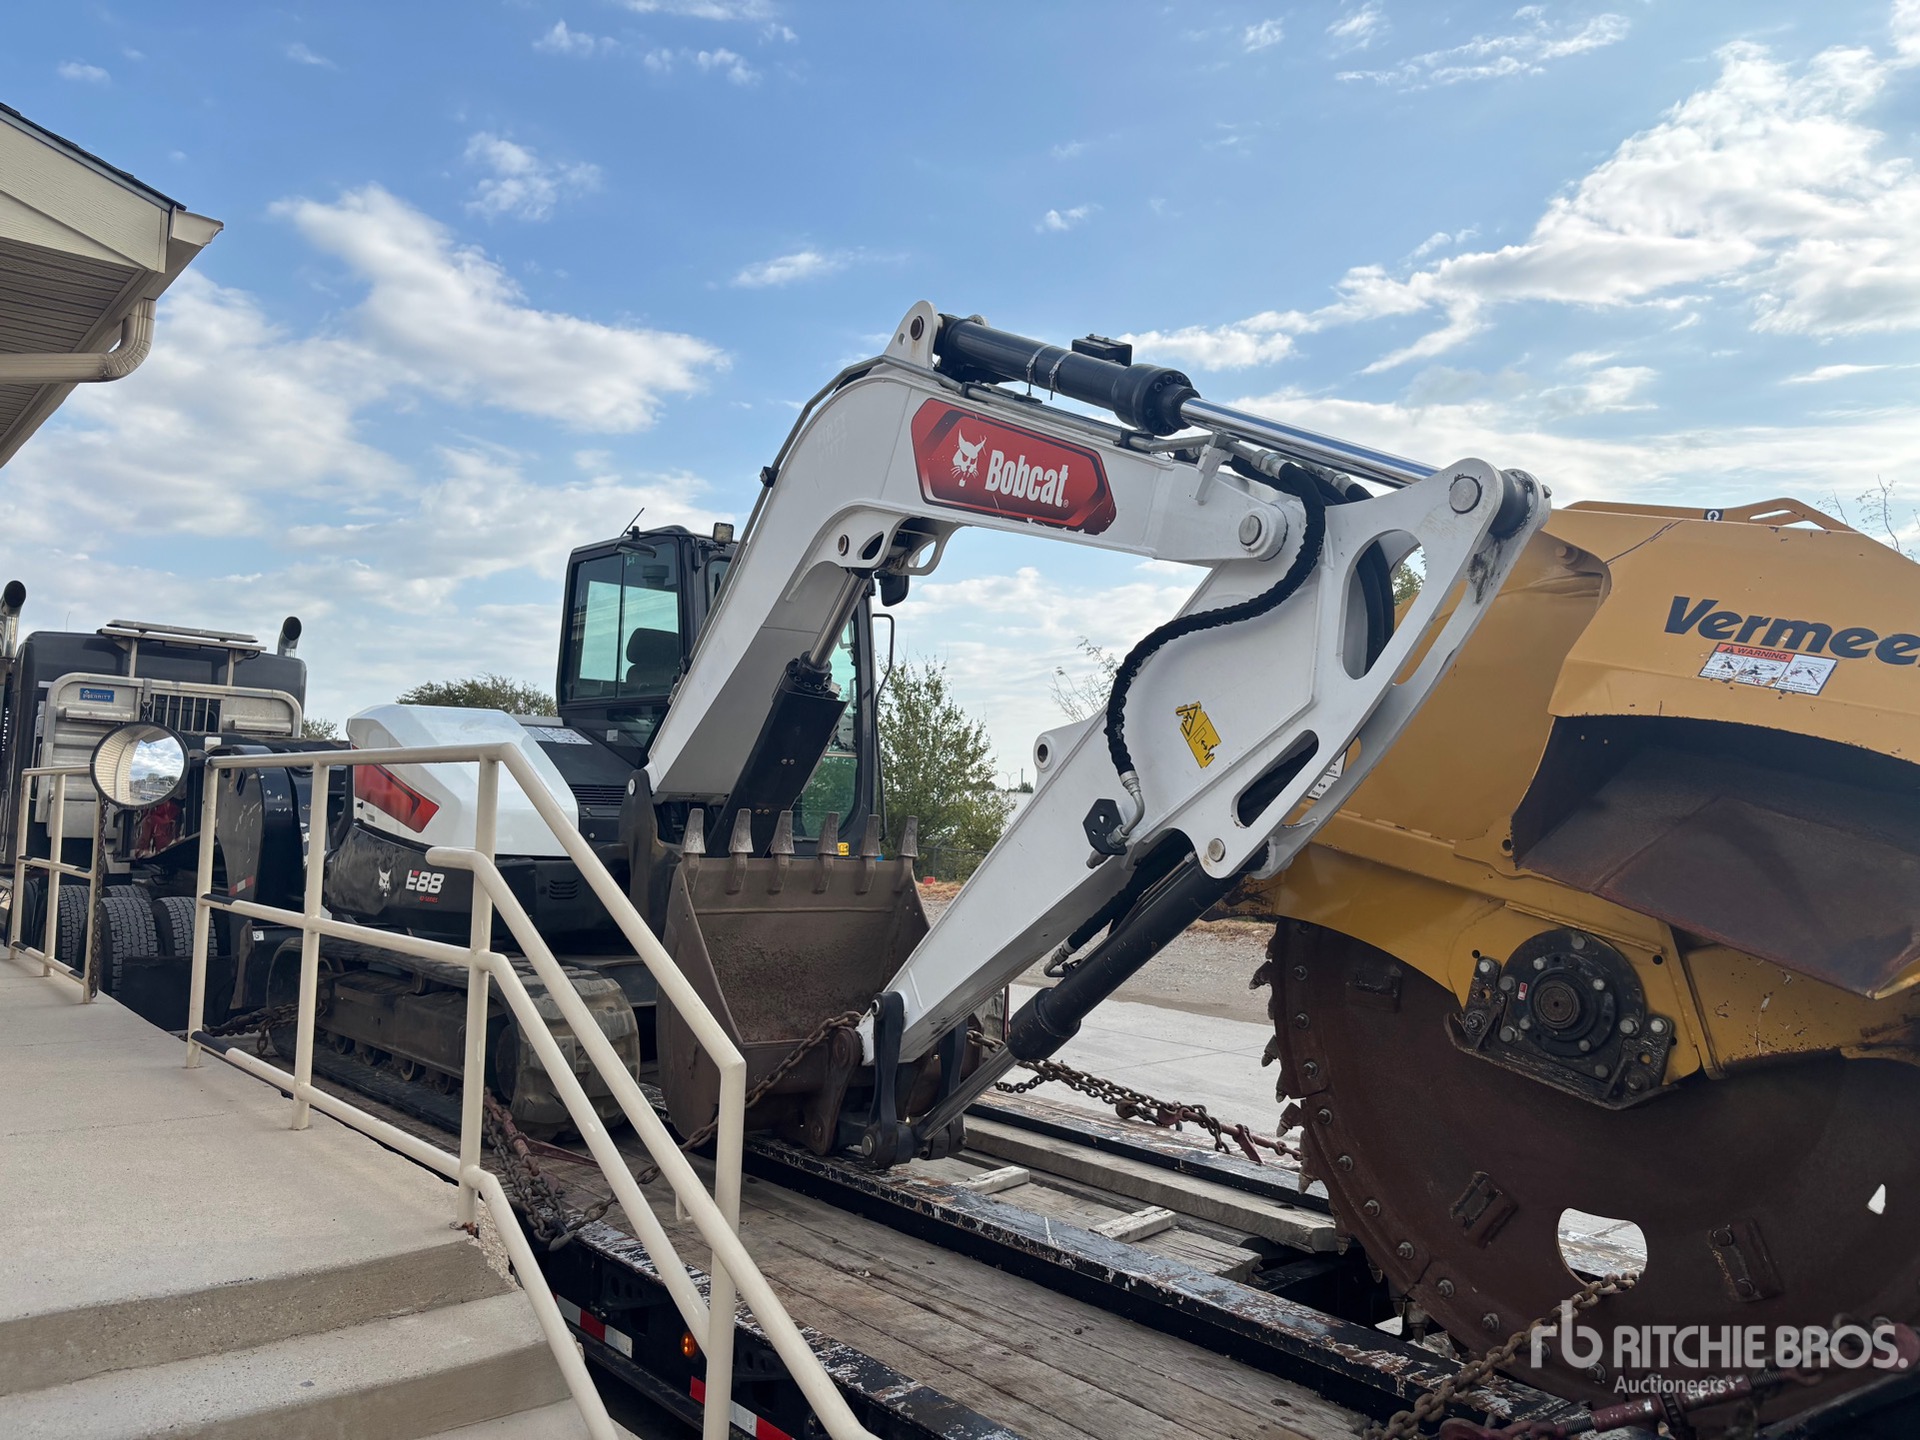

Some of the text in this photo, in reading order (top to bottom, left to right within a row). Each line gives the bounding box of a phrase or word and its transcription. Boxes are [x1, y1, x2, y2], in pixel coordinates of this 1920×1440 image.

[985, 449, 1068, 508] Bobcat
[1664, 595, 1920, 668] Vermee
[1737, 647, 1788, 660] WARNING
[405, 869, 445, 894] E88
